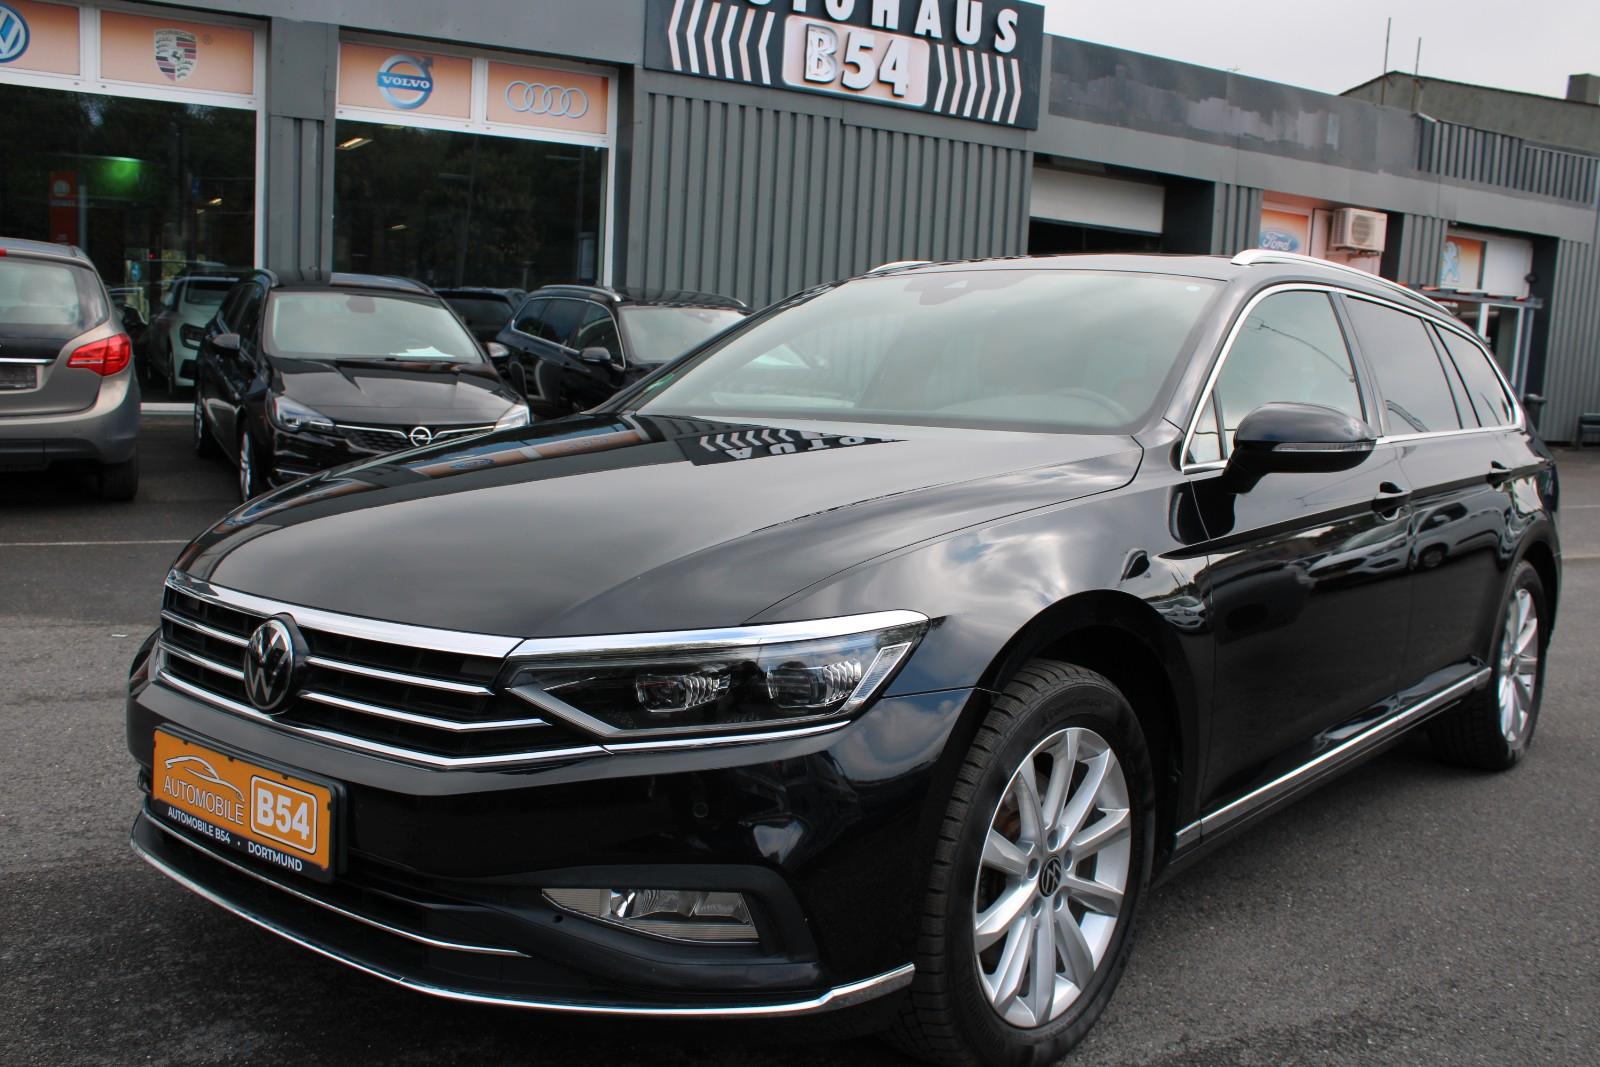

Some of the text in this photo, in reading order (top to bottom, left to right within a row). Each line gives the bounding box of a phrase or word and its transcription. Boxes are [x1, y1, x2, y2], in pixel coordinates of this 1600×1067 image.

[381, 74, 431, 89] VOLVO
[804, 23, 910, 97] B54
[1262, 231, 1292, 251] Ford
[163, 775, 310, 841] AUTOMOBILE B54
[167, 806, 303, 872] AUTOMOBILE B54 DORTMUND
